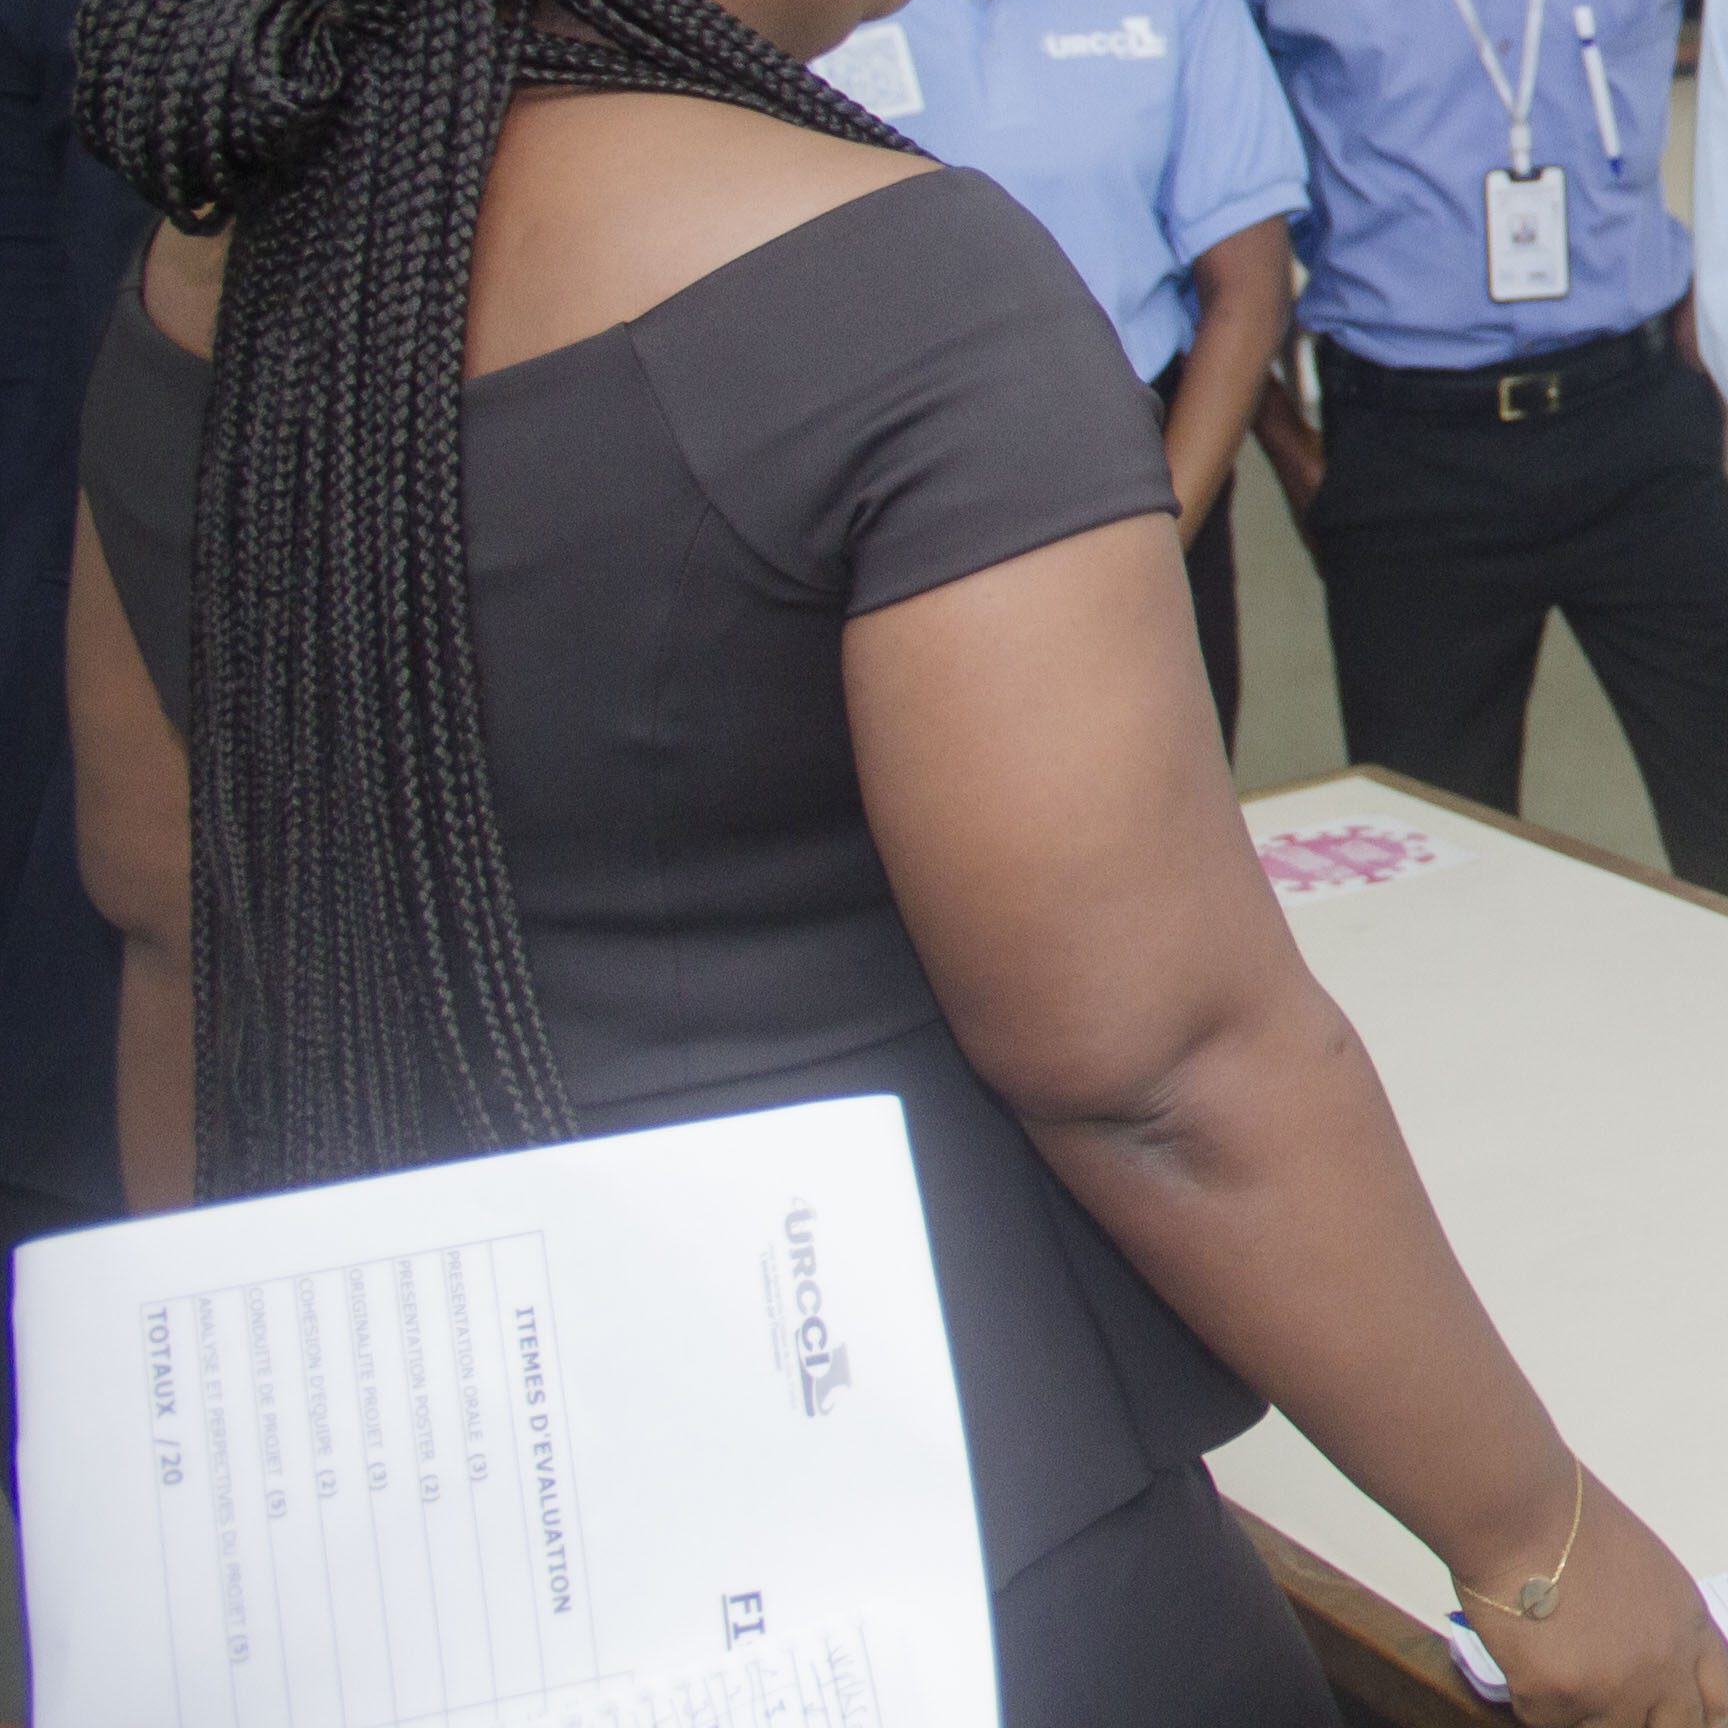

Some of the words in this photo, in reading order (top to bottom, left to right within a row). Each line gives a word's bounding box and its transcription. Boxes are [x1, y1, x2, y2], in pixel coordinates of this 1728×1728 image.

[248, 1286, 273, 1377] CONDUITE
[297, 1278, 322, 1369] COHESION
[445, 1249, 478, 1380] PRESENTATION
[784, 1204, 832, 1370] URCCI
[146, 1307, 177, 1418] TOTAUX
[196, 1297, 221, 1373] ANALYSE
[347, 1268, 375, 1380] ORIGINALITE
[362, 1386, 383, 1449] PROJET
[396, 1259, 427, 1388] PRESENTATION
[412, 1395, 435, 1461] POSTER
[514, 1305, 547, 1407] ITEMES
[204, 1381, 223, 1400] ET
[257, 1384, 276, 1407] DE
[307, 1375, 333, 1455] D'EQUIPE
[461, 1386, 484, 1440] ORALE
[260, 1413, 283, 1476] PROJET
[220, 1532, 239, 1557] DU
[527, 1413, 574, 1616] D'EVALUATION
